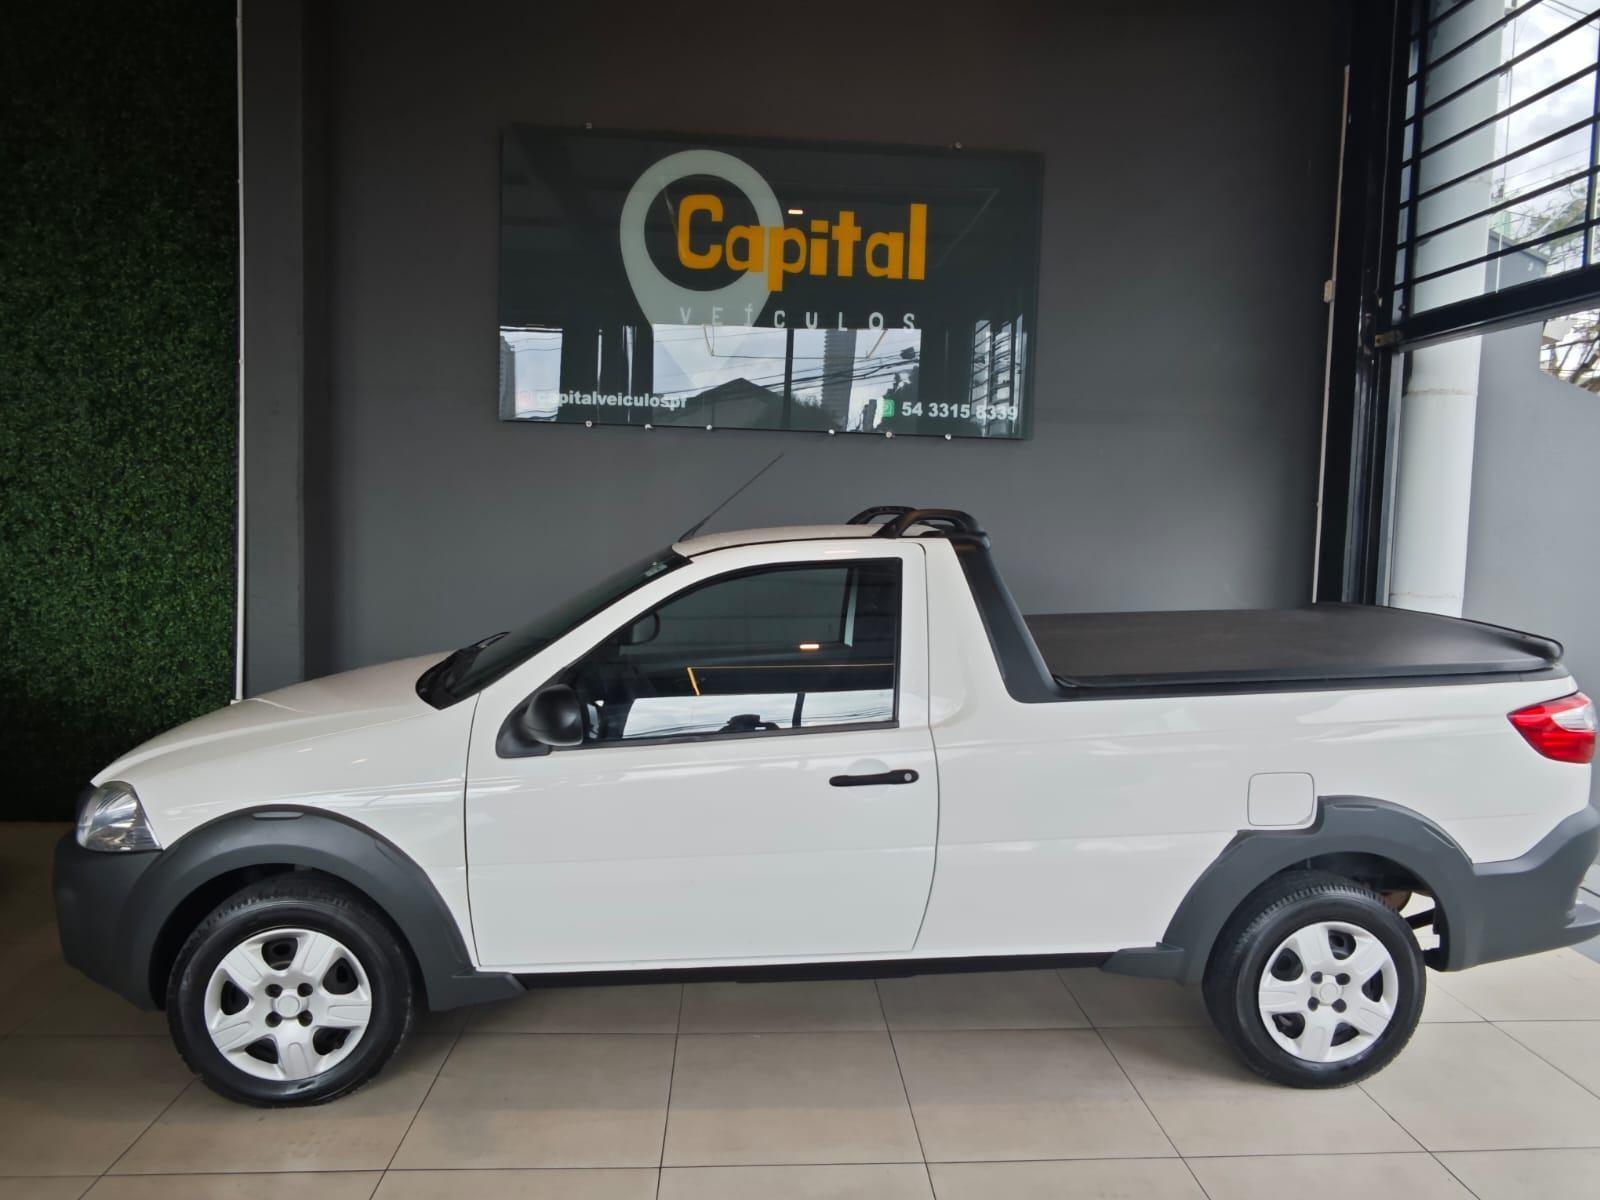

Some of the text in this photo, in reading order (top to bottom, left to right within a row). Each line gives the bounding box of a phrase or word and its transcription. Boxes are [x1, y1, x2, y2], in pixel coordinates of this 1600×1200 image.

[677, 194, 928, 292] Capital
[679, 303, 916, 331] VEÍCULOS
[901, 402, 923, 417] 54
[928, 402, 971, 419] 3315
